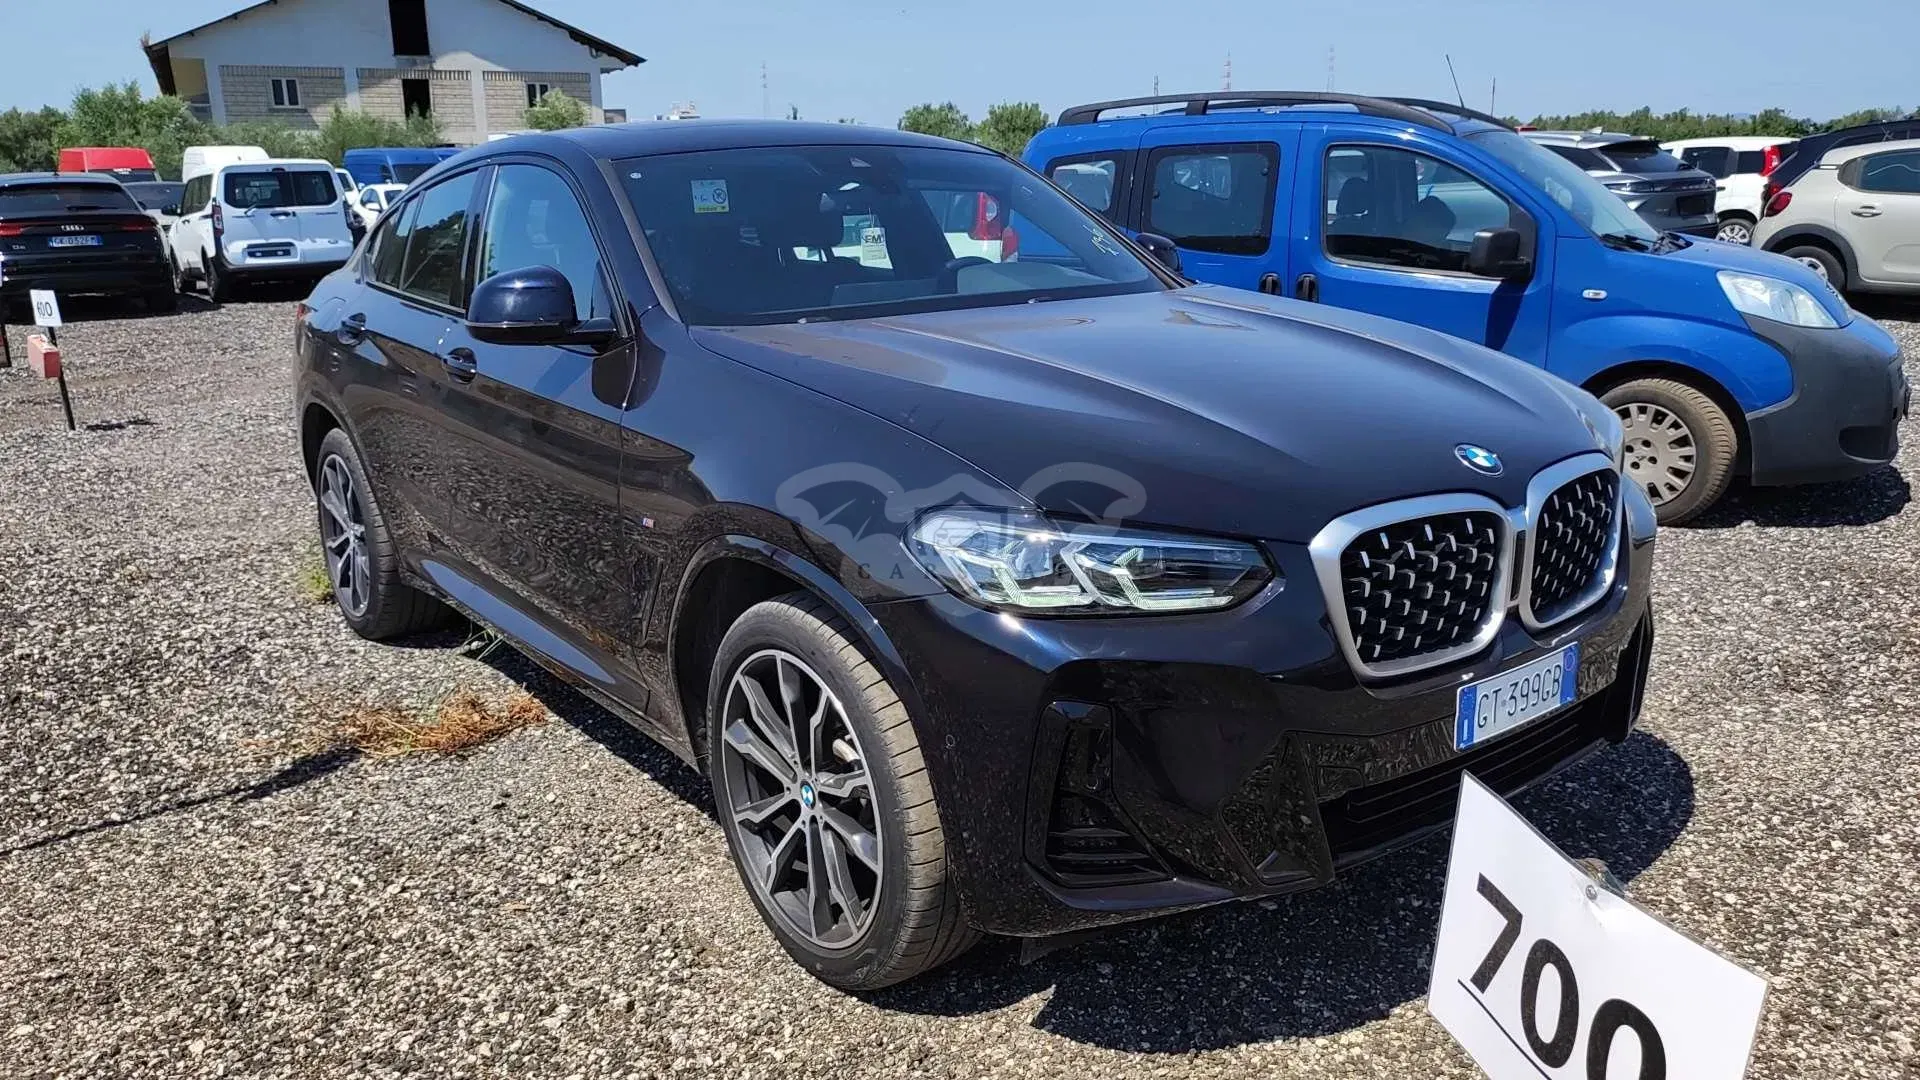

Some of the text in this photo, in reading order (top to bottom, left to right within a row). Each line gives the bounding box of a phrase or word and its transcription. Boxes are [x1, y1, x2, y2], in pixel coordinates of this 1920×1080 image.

[1477, 664, 1562, 729] GT 399GB
[1470, 872, 1667, 1080] 700
